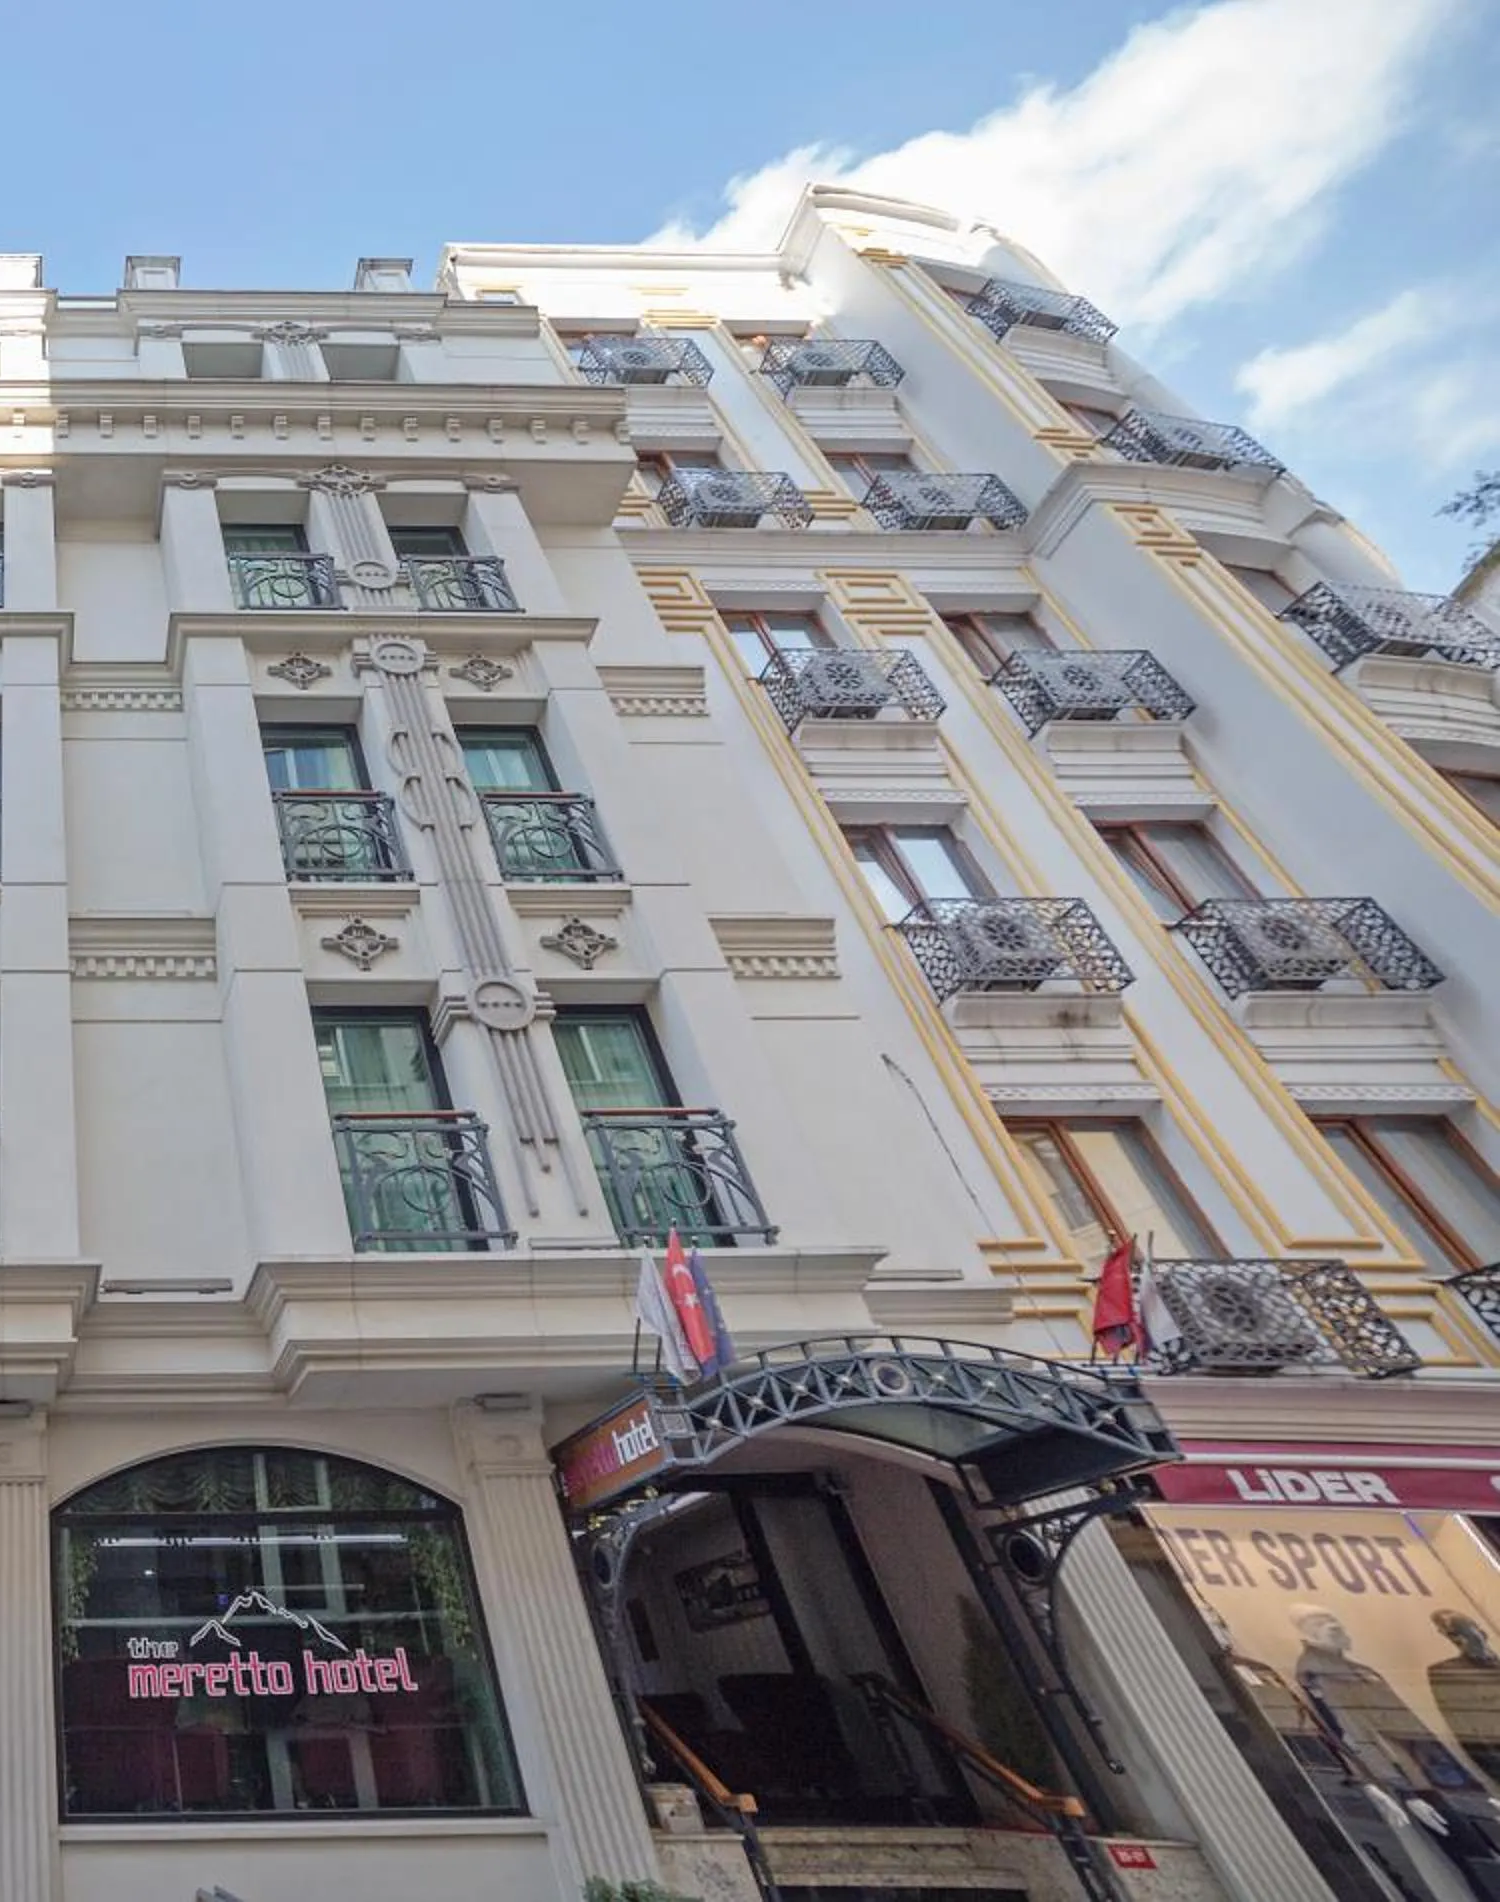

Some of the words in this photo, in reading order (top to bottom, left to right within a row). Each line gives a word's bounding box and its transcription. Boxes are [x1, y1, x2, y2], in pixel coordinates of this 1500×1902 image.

[612, 1410, 659, 1465] hotel
[1251, 1530, 1432, 1597] SPORT
[128, 1637, 179, 1658] the
[128, 1650, 293, 1698] meretto
[303, 1647, 419, 1695] hotel
